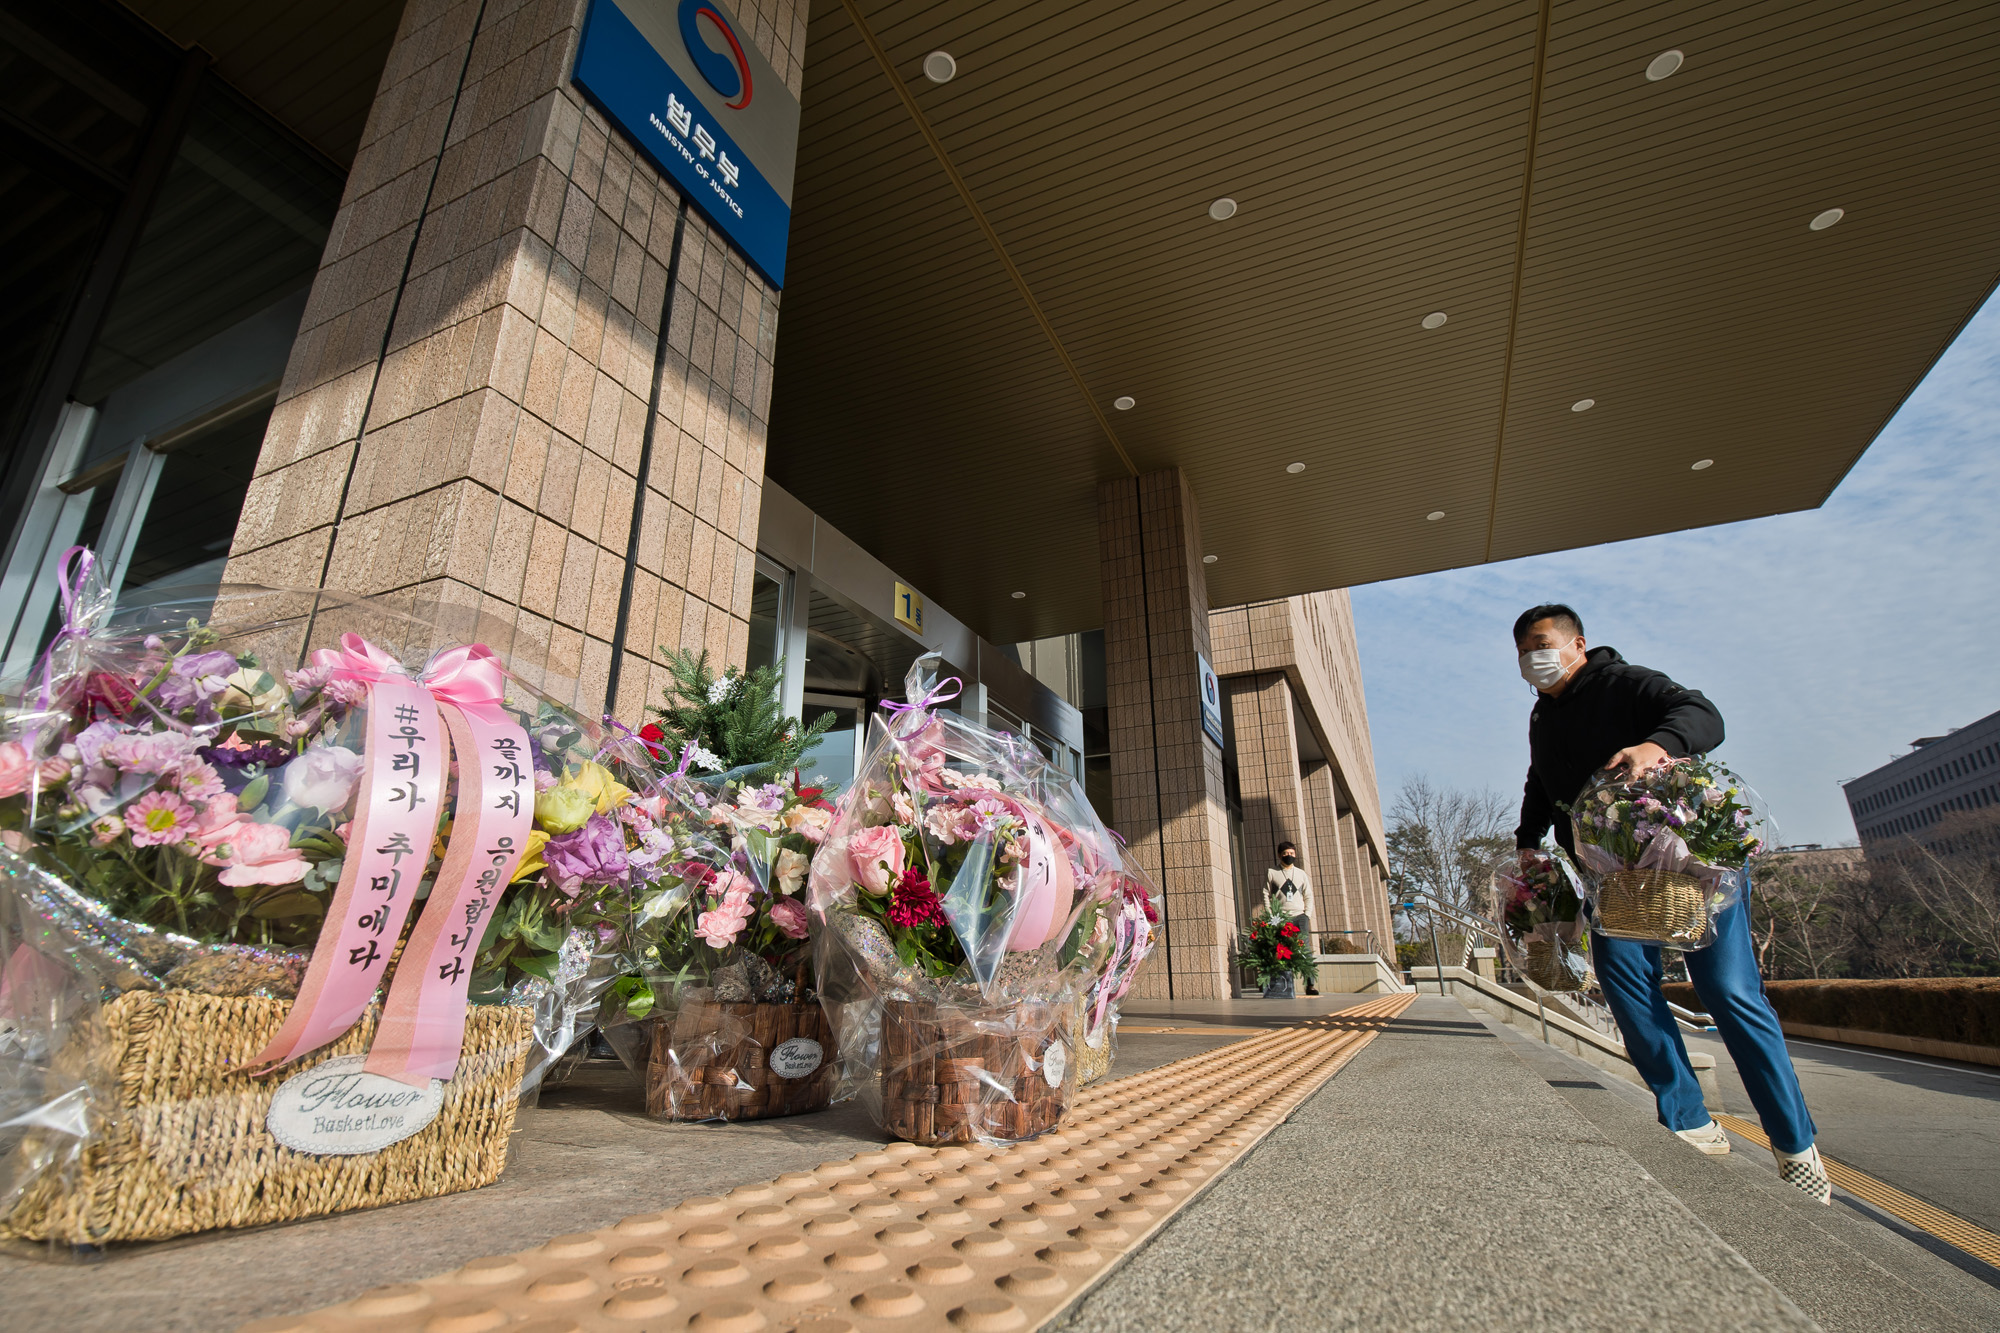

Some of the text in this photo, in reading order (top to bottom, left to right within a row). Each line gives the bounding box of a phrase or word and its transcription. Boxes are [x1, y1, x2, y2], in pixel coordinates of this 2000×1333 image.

[649, 112, 743, 219] MINISTRY OF JUSTICE
[666, 92, 739, 188] 법무부
[349, 703, 426, 972] #우리가 추미애다
[439, 738, 526, 985] 끝까지 응원합니다
[300, 1072, 423, 1113] Flower
[780, 1045, 817, 1061] Flower
